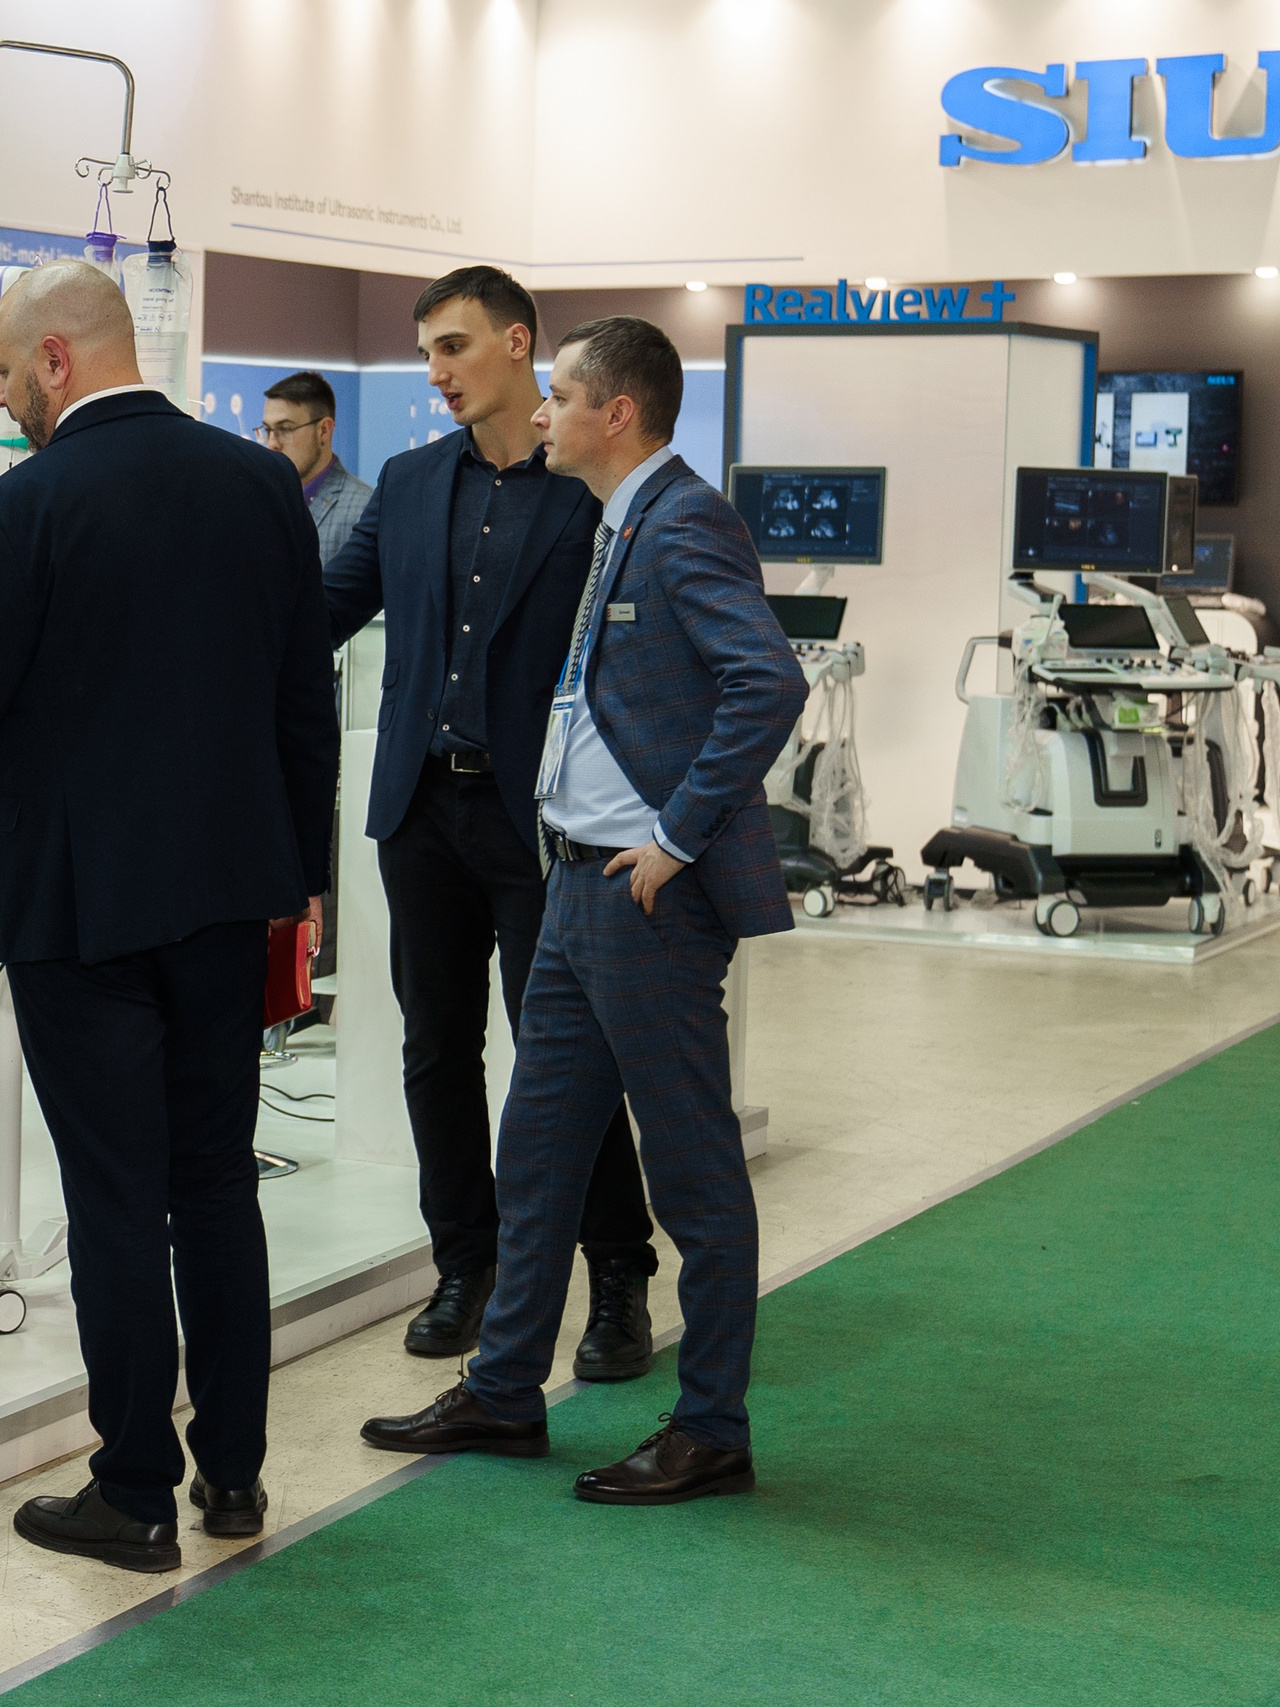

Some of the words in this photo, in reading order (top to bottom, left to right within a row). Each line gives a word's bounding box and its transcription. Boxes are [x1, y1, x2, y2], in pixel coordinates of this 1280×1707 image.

[231, 186, 272, 209] Shantou
[274, 191, 315, 213] Institute
[316, 199, 327, 216] of
[329, 199, 375, 222] Ultrasonic
[377, 206, 428, 228] Instruments
[446, 217, 463, 236] Ltd.
[744, 279, 969, 324] Realview
